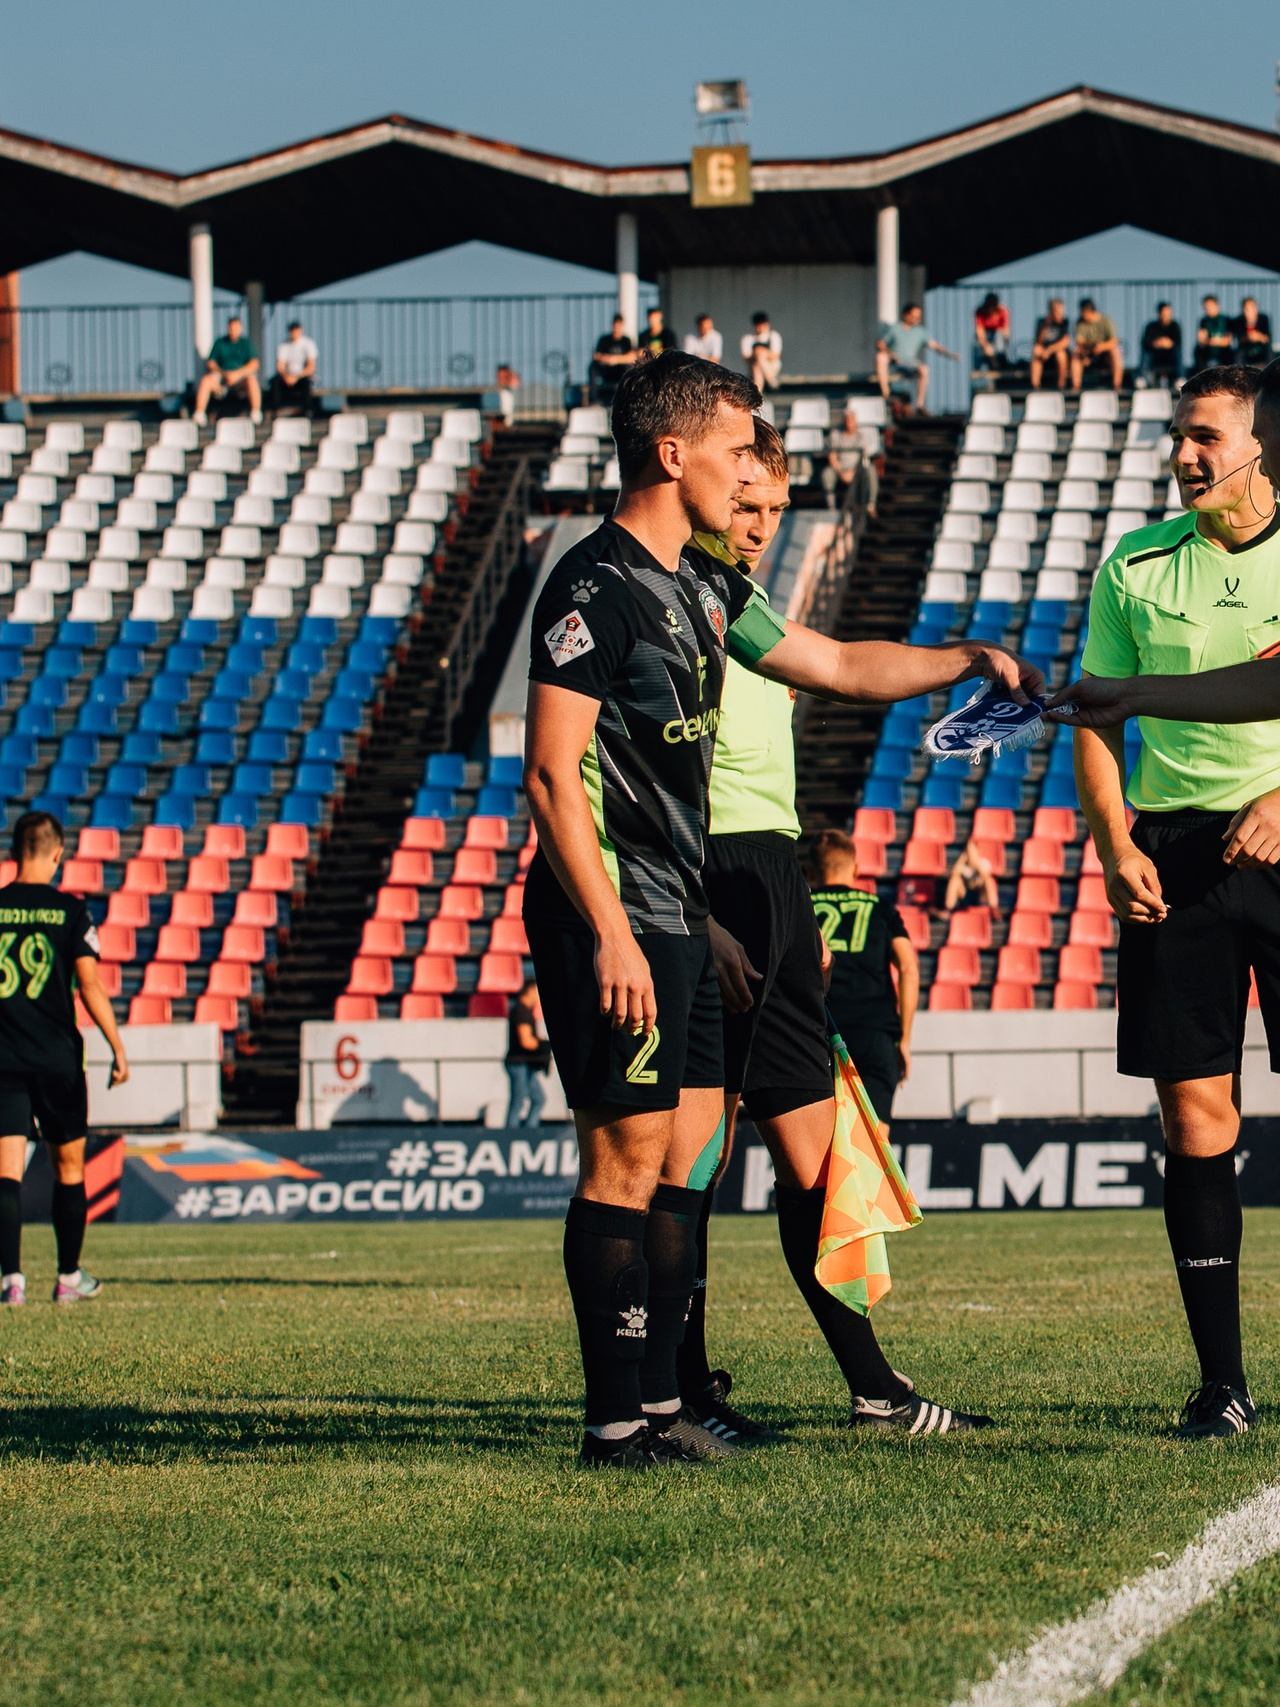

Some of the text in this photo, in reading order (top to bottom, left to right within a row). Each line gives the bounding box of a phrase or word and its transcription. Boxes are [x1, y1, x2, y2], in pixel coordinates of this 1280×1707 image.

[706, 152, 736, 198] 6
[1212, 598, 1248, 609] JÖGEL
[813, 901, 874, 953] 27
[335, 1034, 361, 1080] 6
[626, 1020, 660, 1084] 2
[175, 1179, 485, 1218] #ЗАРОССИЮ
[742, 1141, 1147, 1210] KLME
[616, 1328, 648, 1338] KELM
